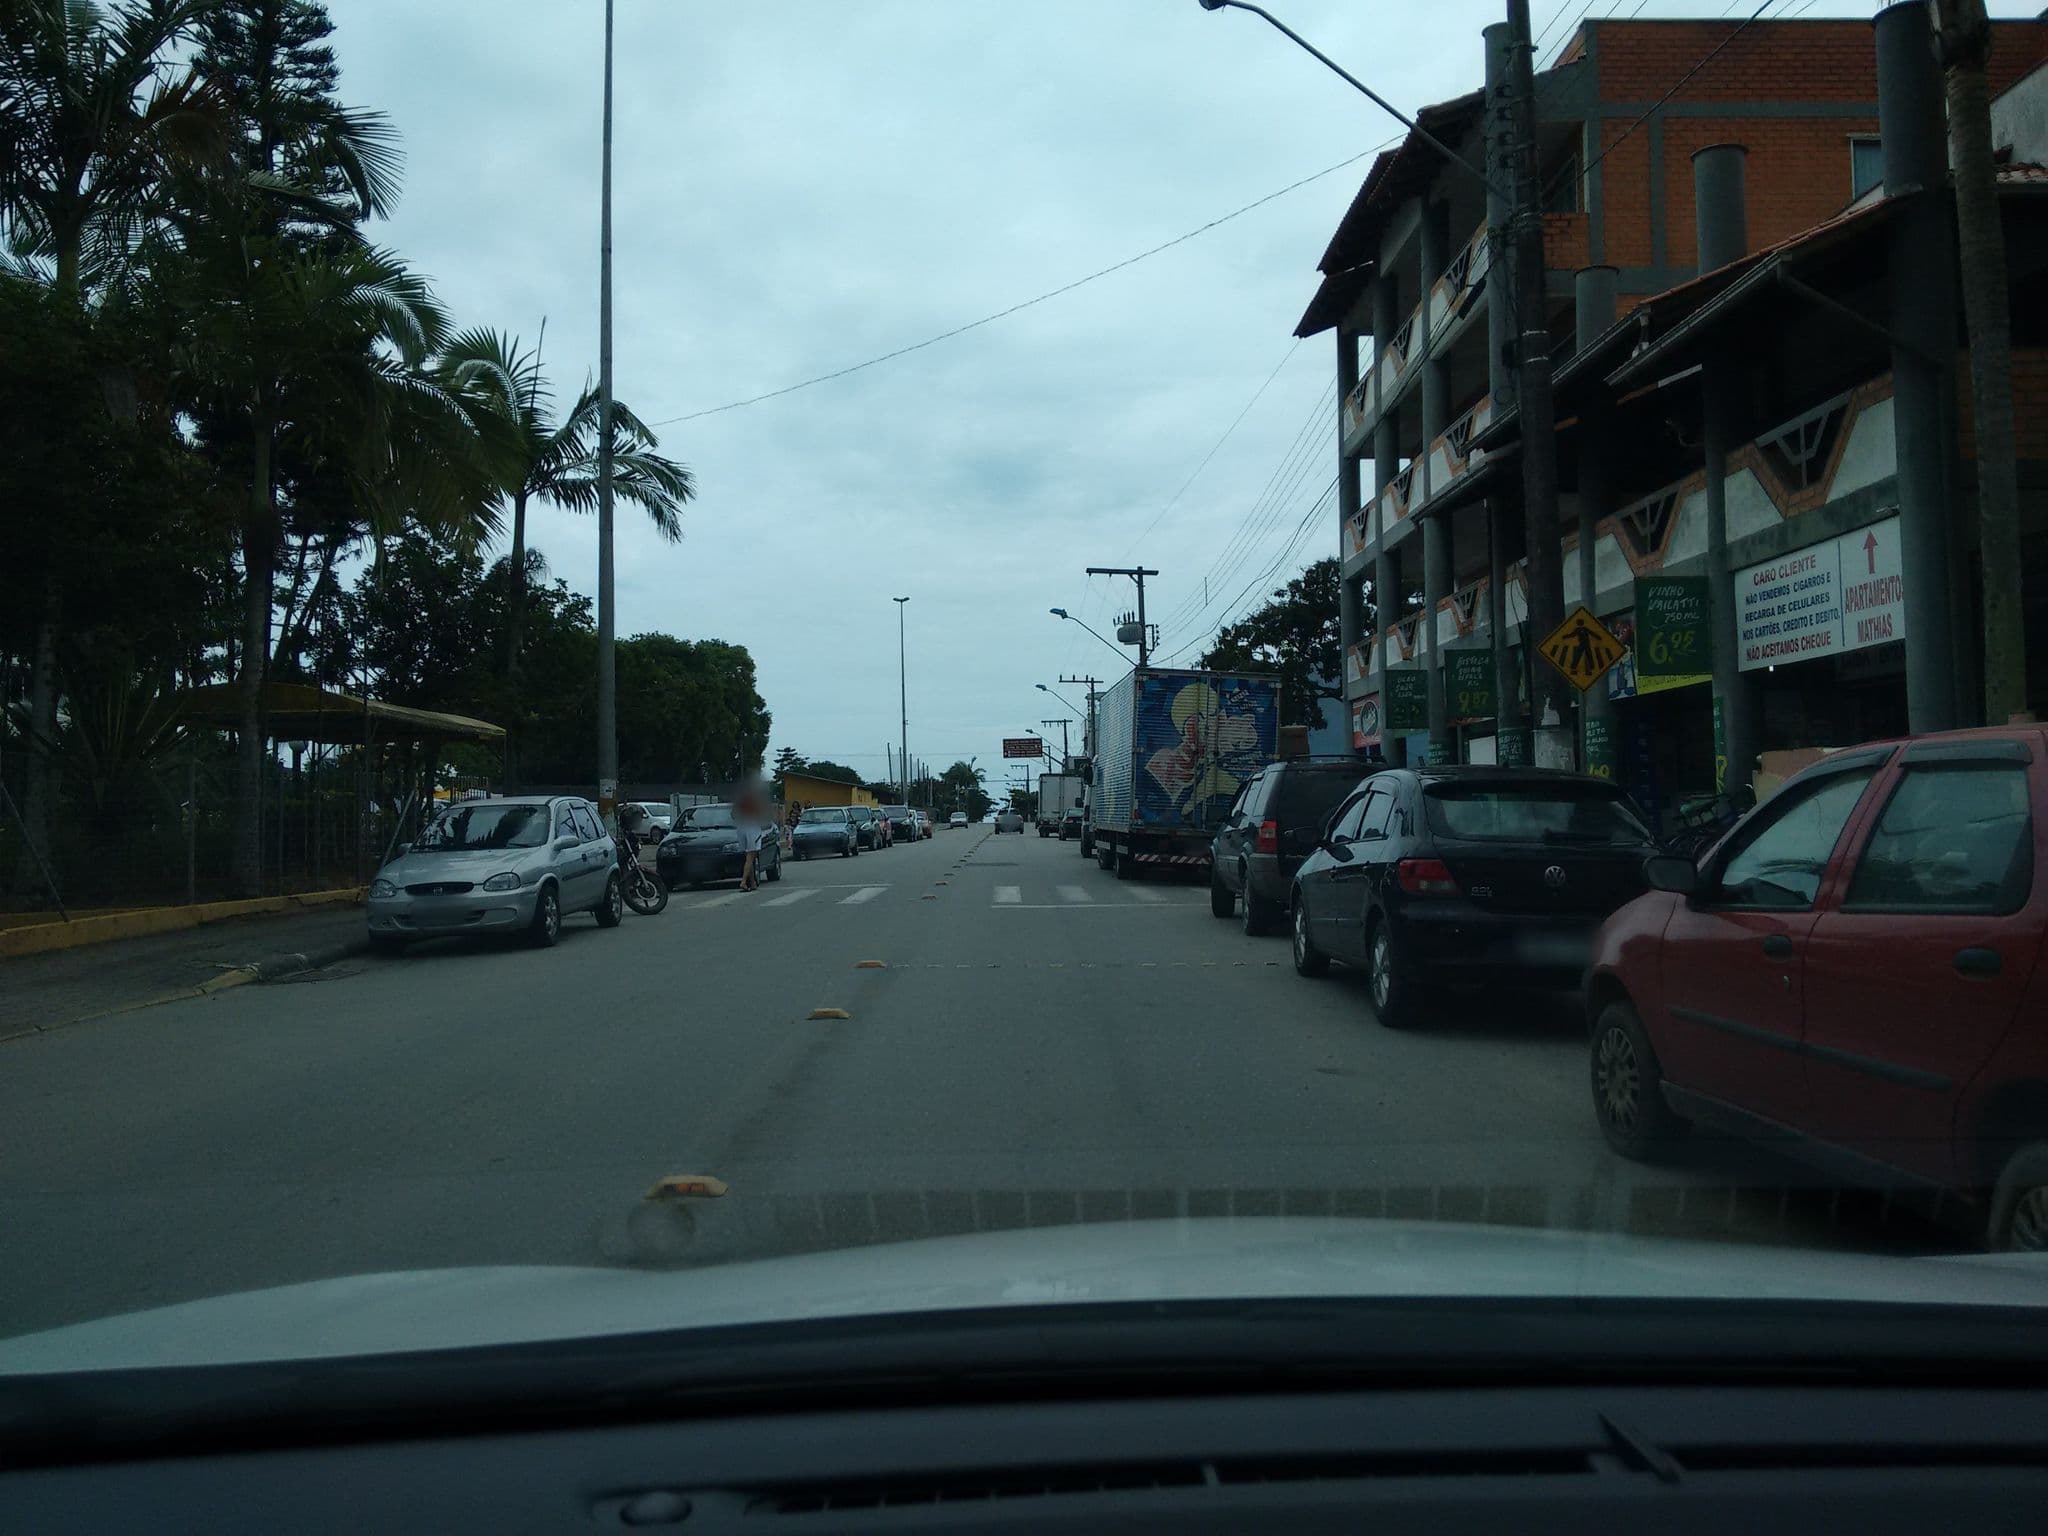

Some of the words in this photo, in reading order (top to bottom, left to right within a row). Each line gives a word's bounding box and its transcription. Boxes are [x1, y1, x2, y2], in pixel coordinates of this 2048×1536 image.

[1753, 567, 1777, 586] CARO
[1778, 554, 1817, 578] CLIENTE
[1647, 585, 1685, 598] VINHO
[1745, 592, 1758, 606] NÃO
[1758, 584, 1790, 602] VENDEMOS
[1793, 573, 1826, 593] CIGARROS
[1826, 571, 1832, 583] E
[1845, 574, 1904, 614] APARTAMENTO
[1745, 607, 1776, 623] RECARGA
[1777, 604, 1786, 615] DE
[1787, 591, 1830, 612] CELULARES
[1742, 628, 1754, 641] NOS
[1809, 614, 1814, 626] E
[1857, 612, 1893, 644] MATHIAS
[1746, 644, 1760, 660] NÃO
[1760, 638, 1800, 660] ACEITAMOS
[1800, 631, 1832, 651] CHEQUE
